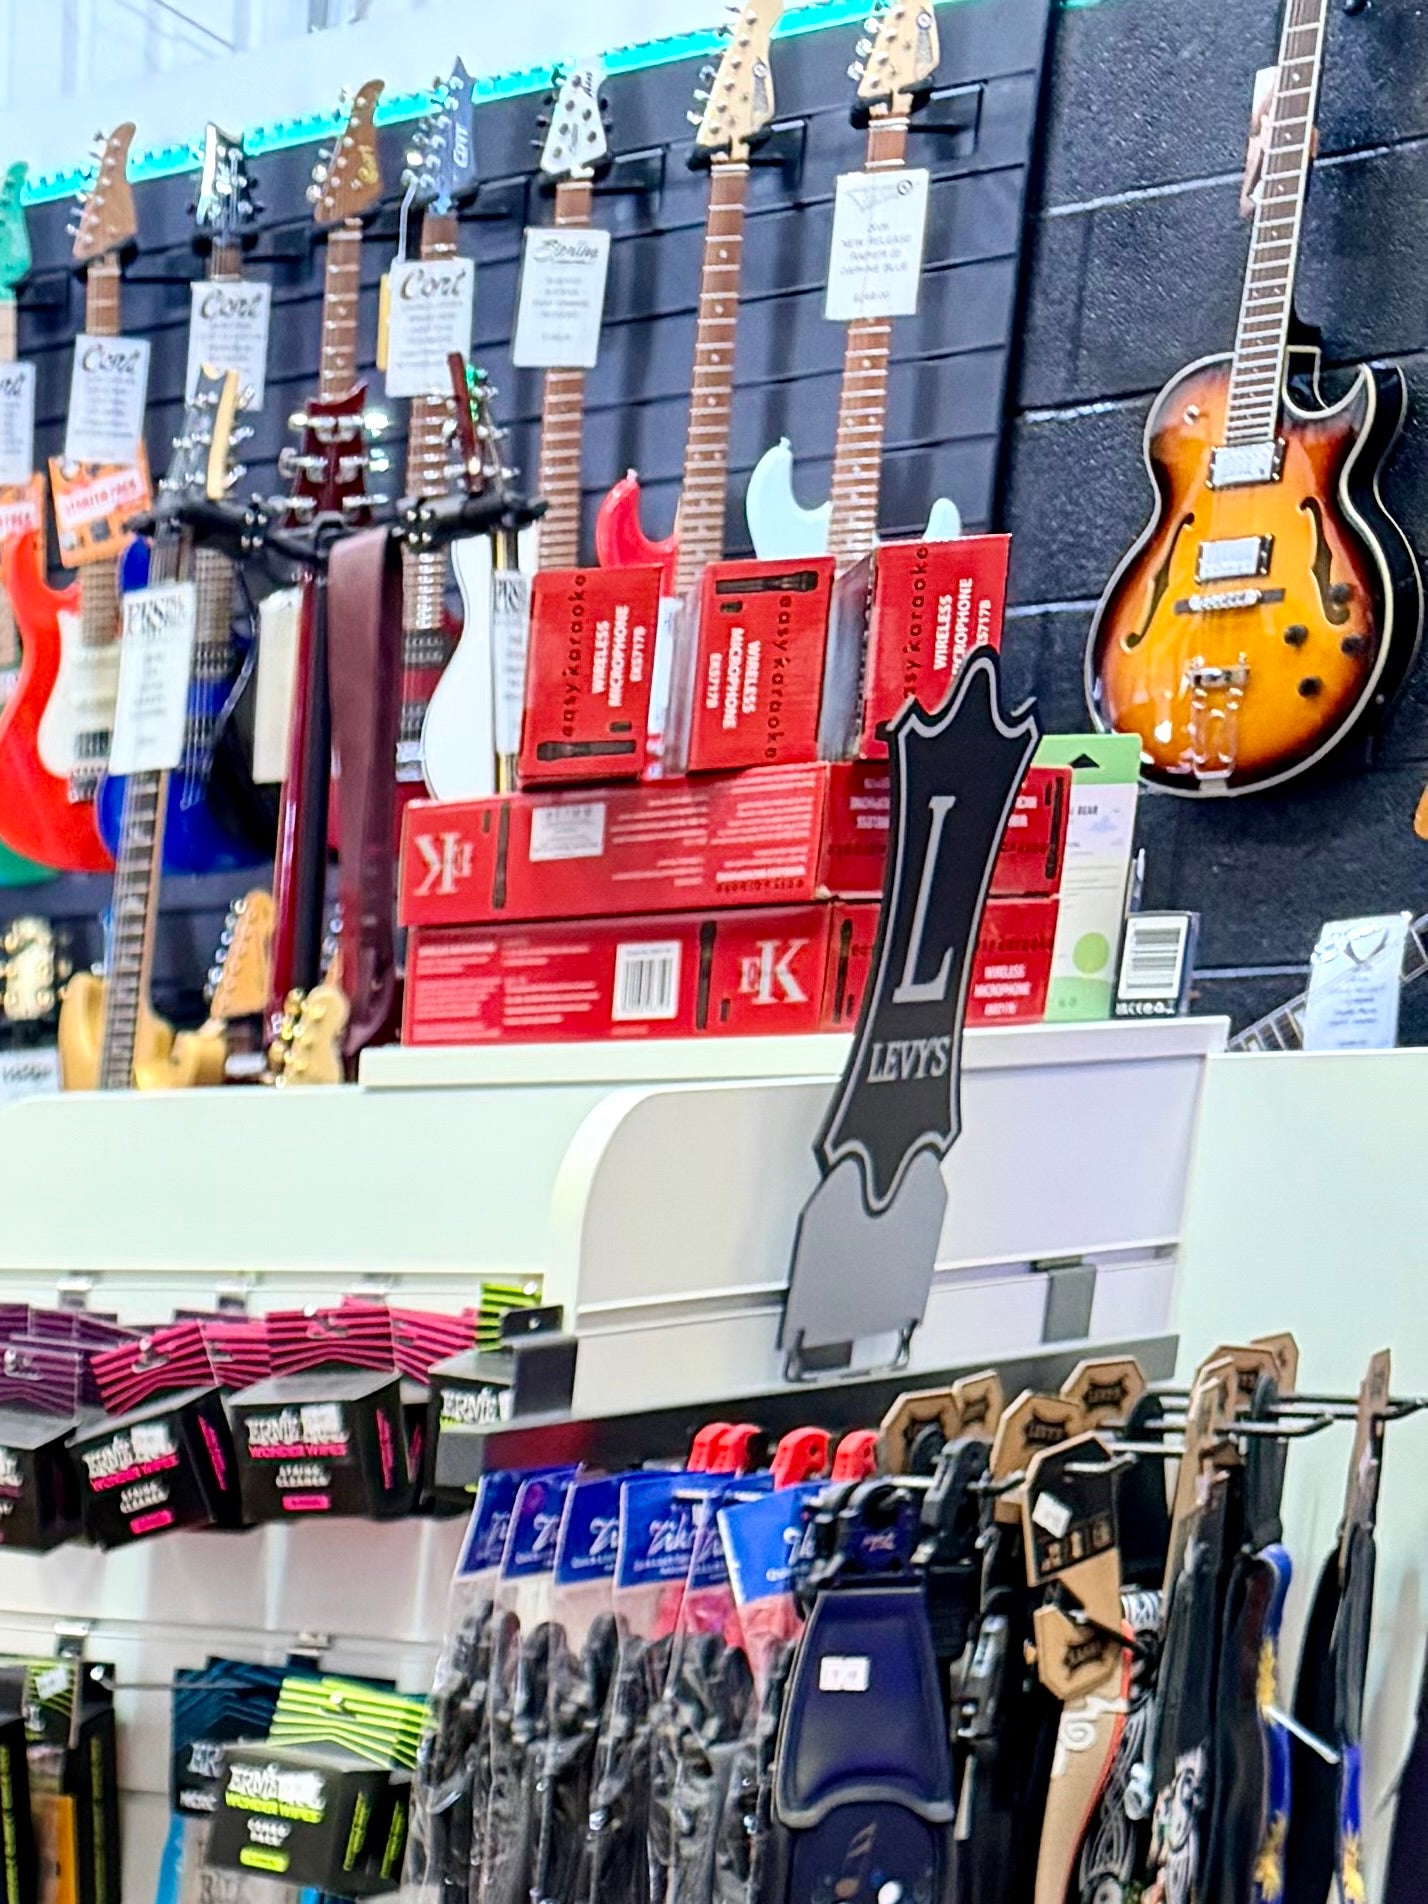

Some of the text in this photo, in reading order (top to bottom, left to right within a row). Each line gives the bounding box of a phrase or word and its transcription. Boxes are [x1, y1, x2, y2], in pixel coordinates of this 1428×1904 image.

[591, 620, 610, 694] WIRELESS
[608, 605, 629, 707] MICROPHONE
[933, 595, 952, 670] WIRELESS
[723, 627, 744, 730] MICROPHONE
[742, 640, 761, 714] WIRELESS
[867, 1036, 951, 1084] LEVY'S
[226, 1790, 278, 1815] WONDER
[280, 1801, 324, 1824] WIPES
